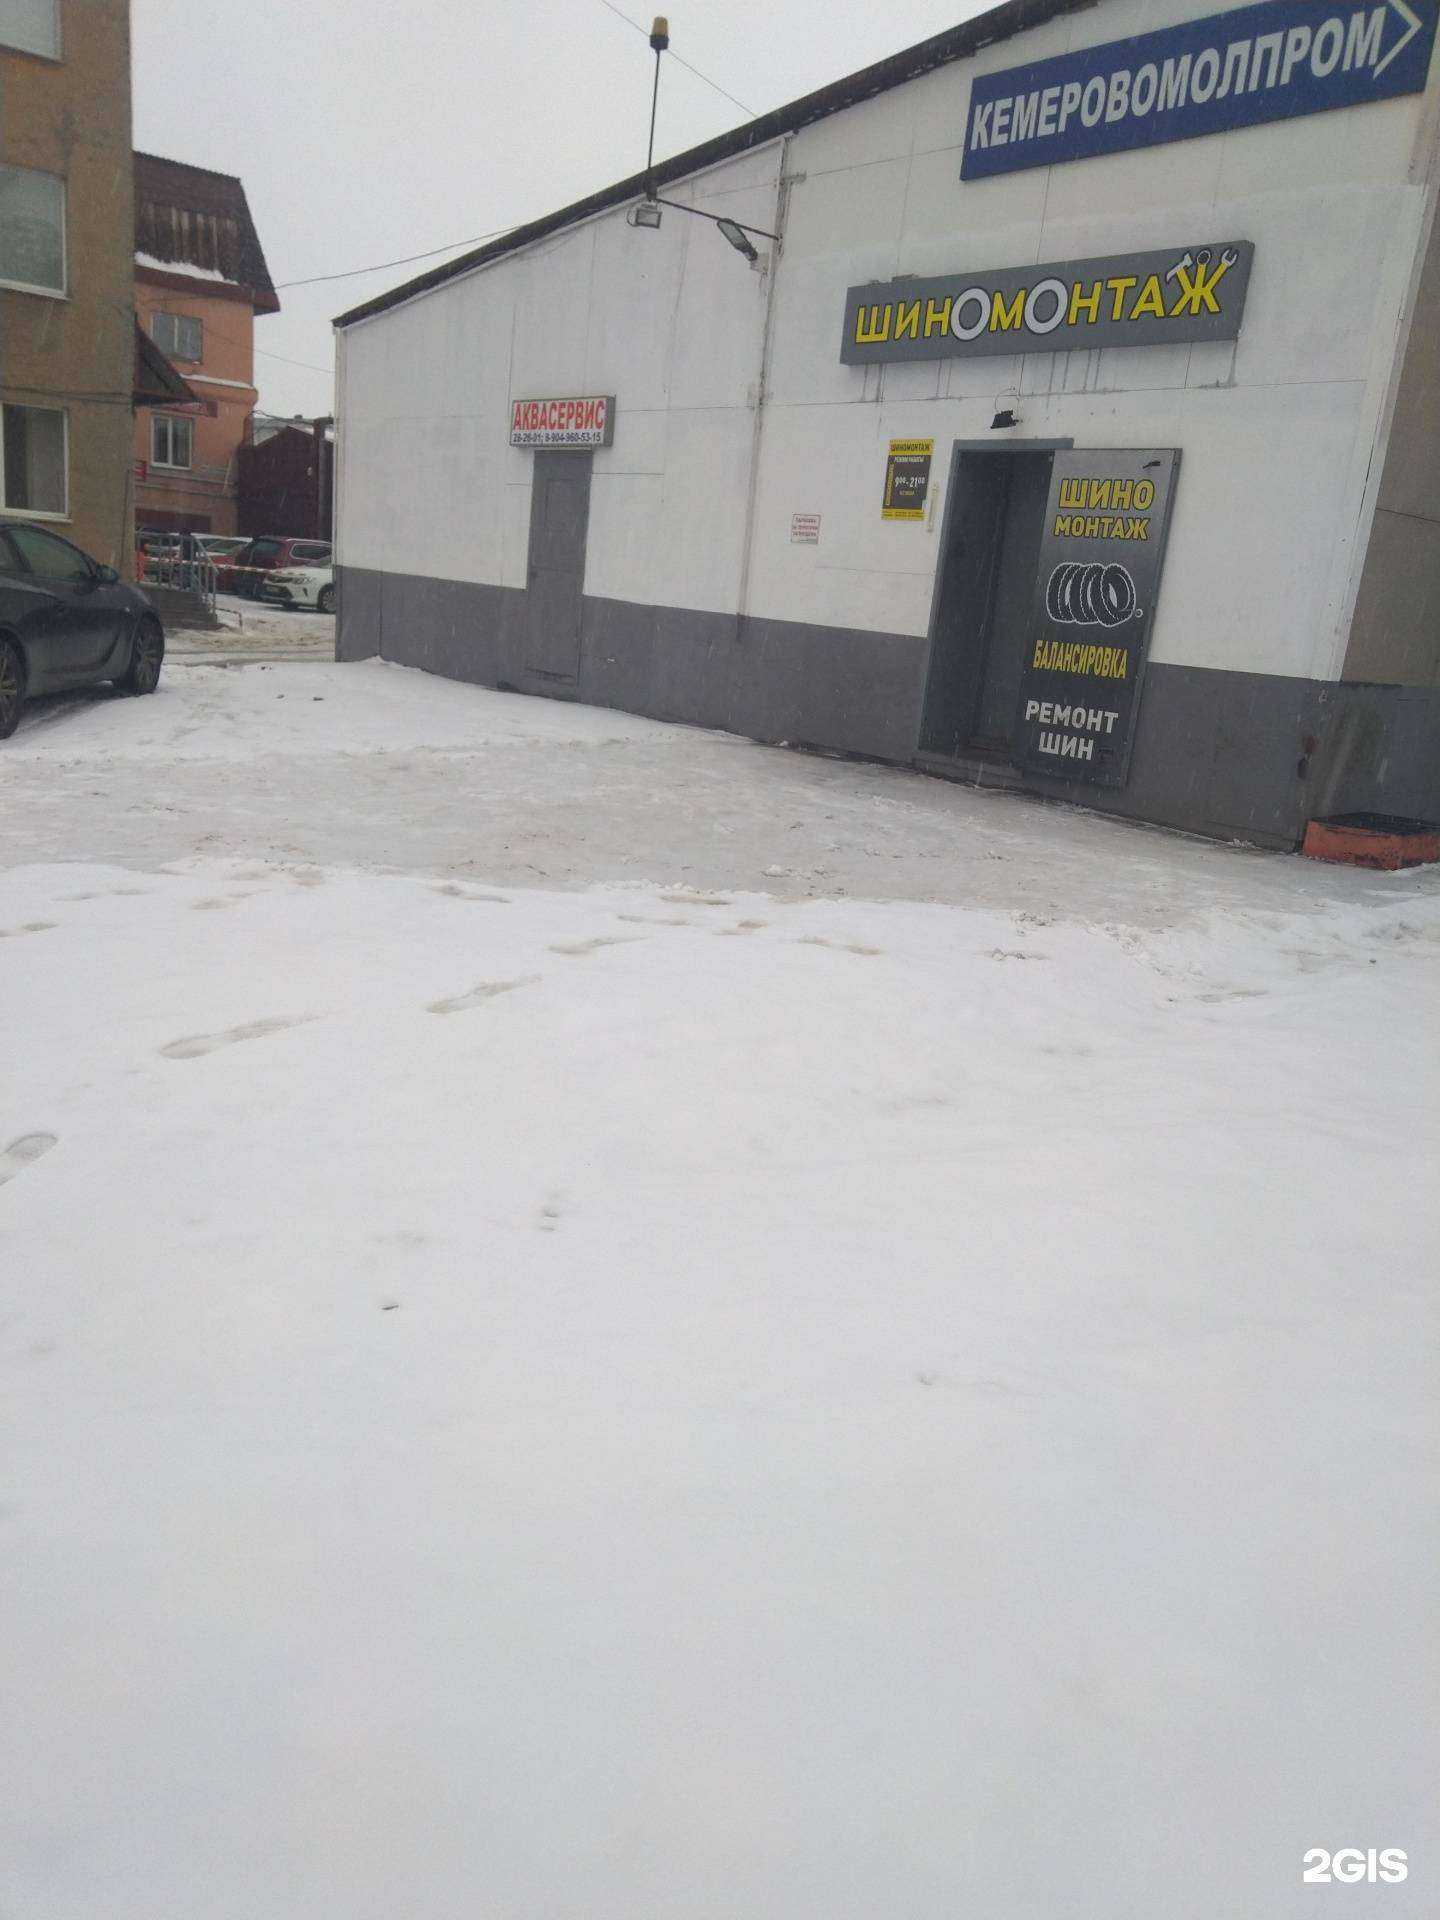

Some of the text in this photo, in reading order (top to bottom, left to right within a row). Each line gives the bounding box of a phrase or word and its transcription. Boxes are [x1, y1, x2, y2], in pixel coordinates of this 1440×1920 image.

[970, 6, 1387, 150] КЕМЕРОВОМОЛПРОМ
[855, 249, 1238, 343] ШИНОМОНТАЖ
[513, 400, 605, 430] АКВАСЕРВИС
[1058, 478, 1155, 510] ШИНО
[1054, 515, 1151, 541] МОНТАЖ
[1033, 640, 1128, 680] БАЛАНСИРОВКА
[1025, 700, 1119, 734] РЕМОНТ
[1038, 731, 1094, 761] ШИН
